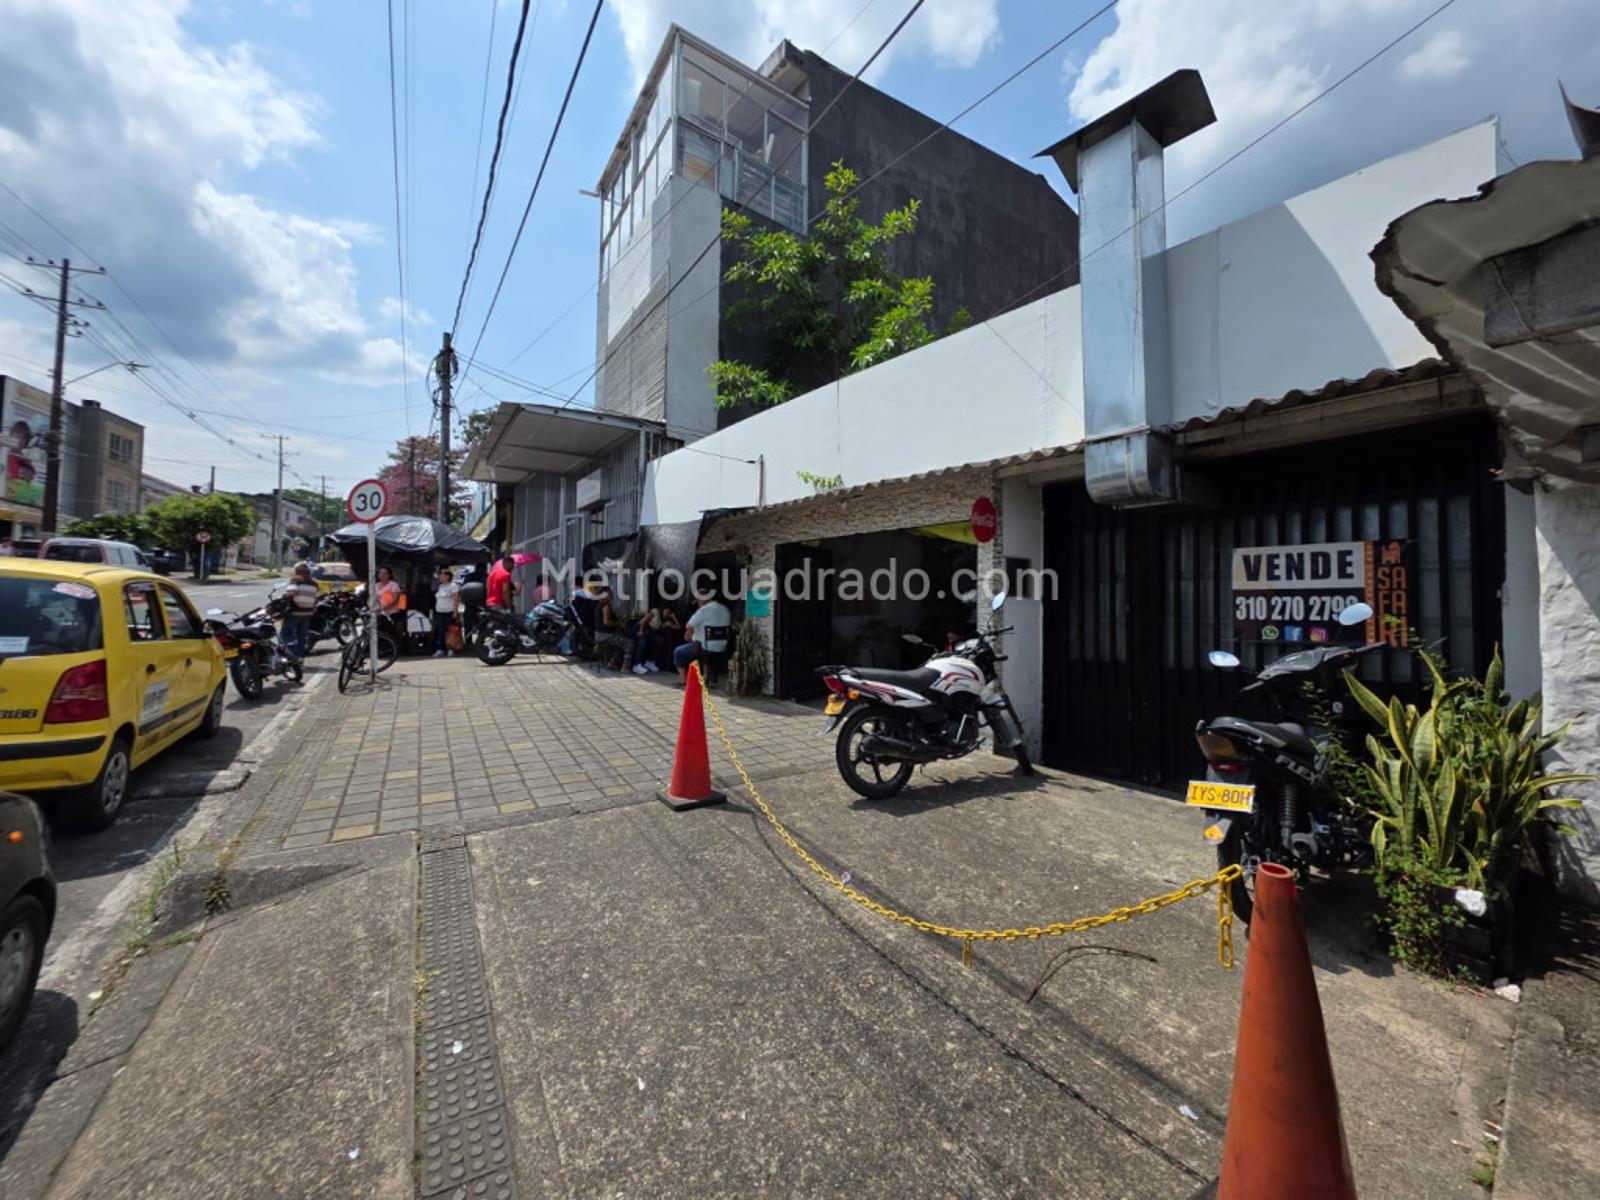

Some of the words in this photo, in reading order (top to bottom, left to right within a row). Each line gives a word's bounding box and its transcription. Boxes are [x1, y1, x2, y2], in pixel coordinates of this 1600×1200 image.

[356, 491, 381, 511] 30
[1242, 550, 1354, 582] VENDE
[1377, 567, 1407, 589] SA
[1235, 596, 1267, 621] 310
[1271, 596, 1305, 621] 270
